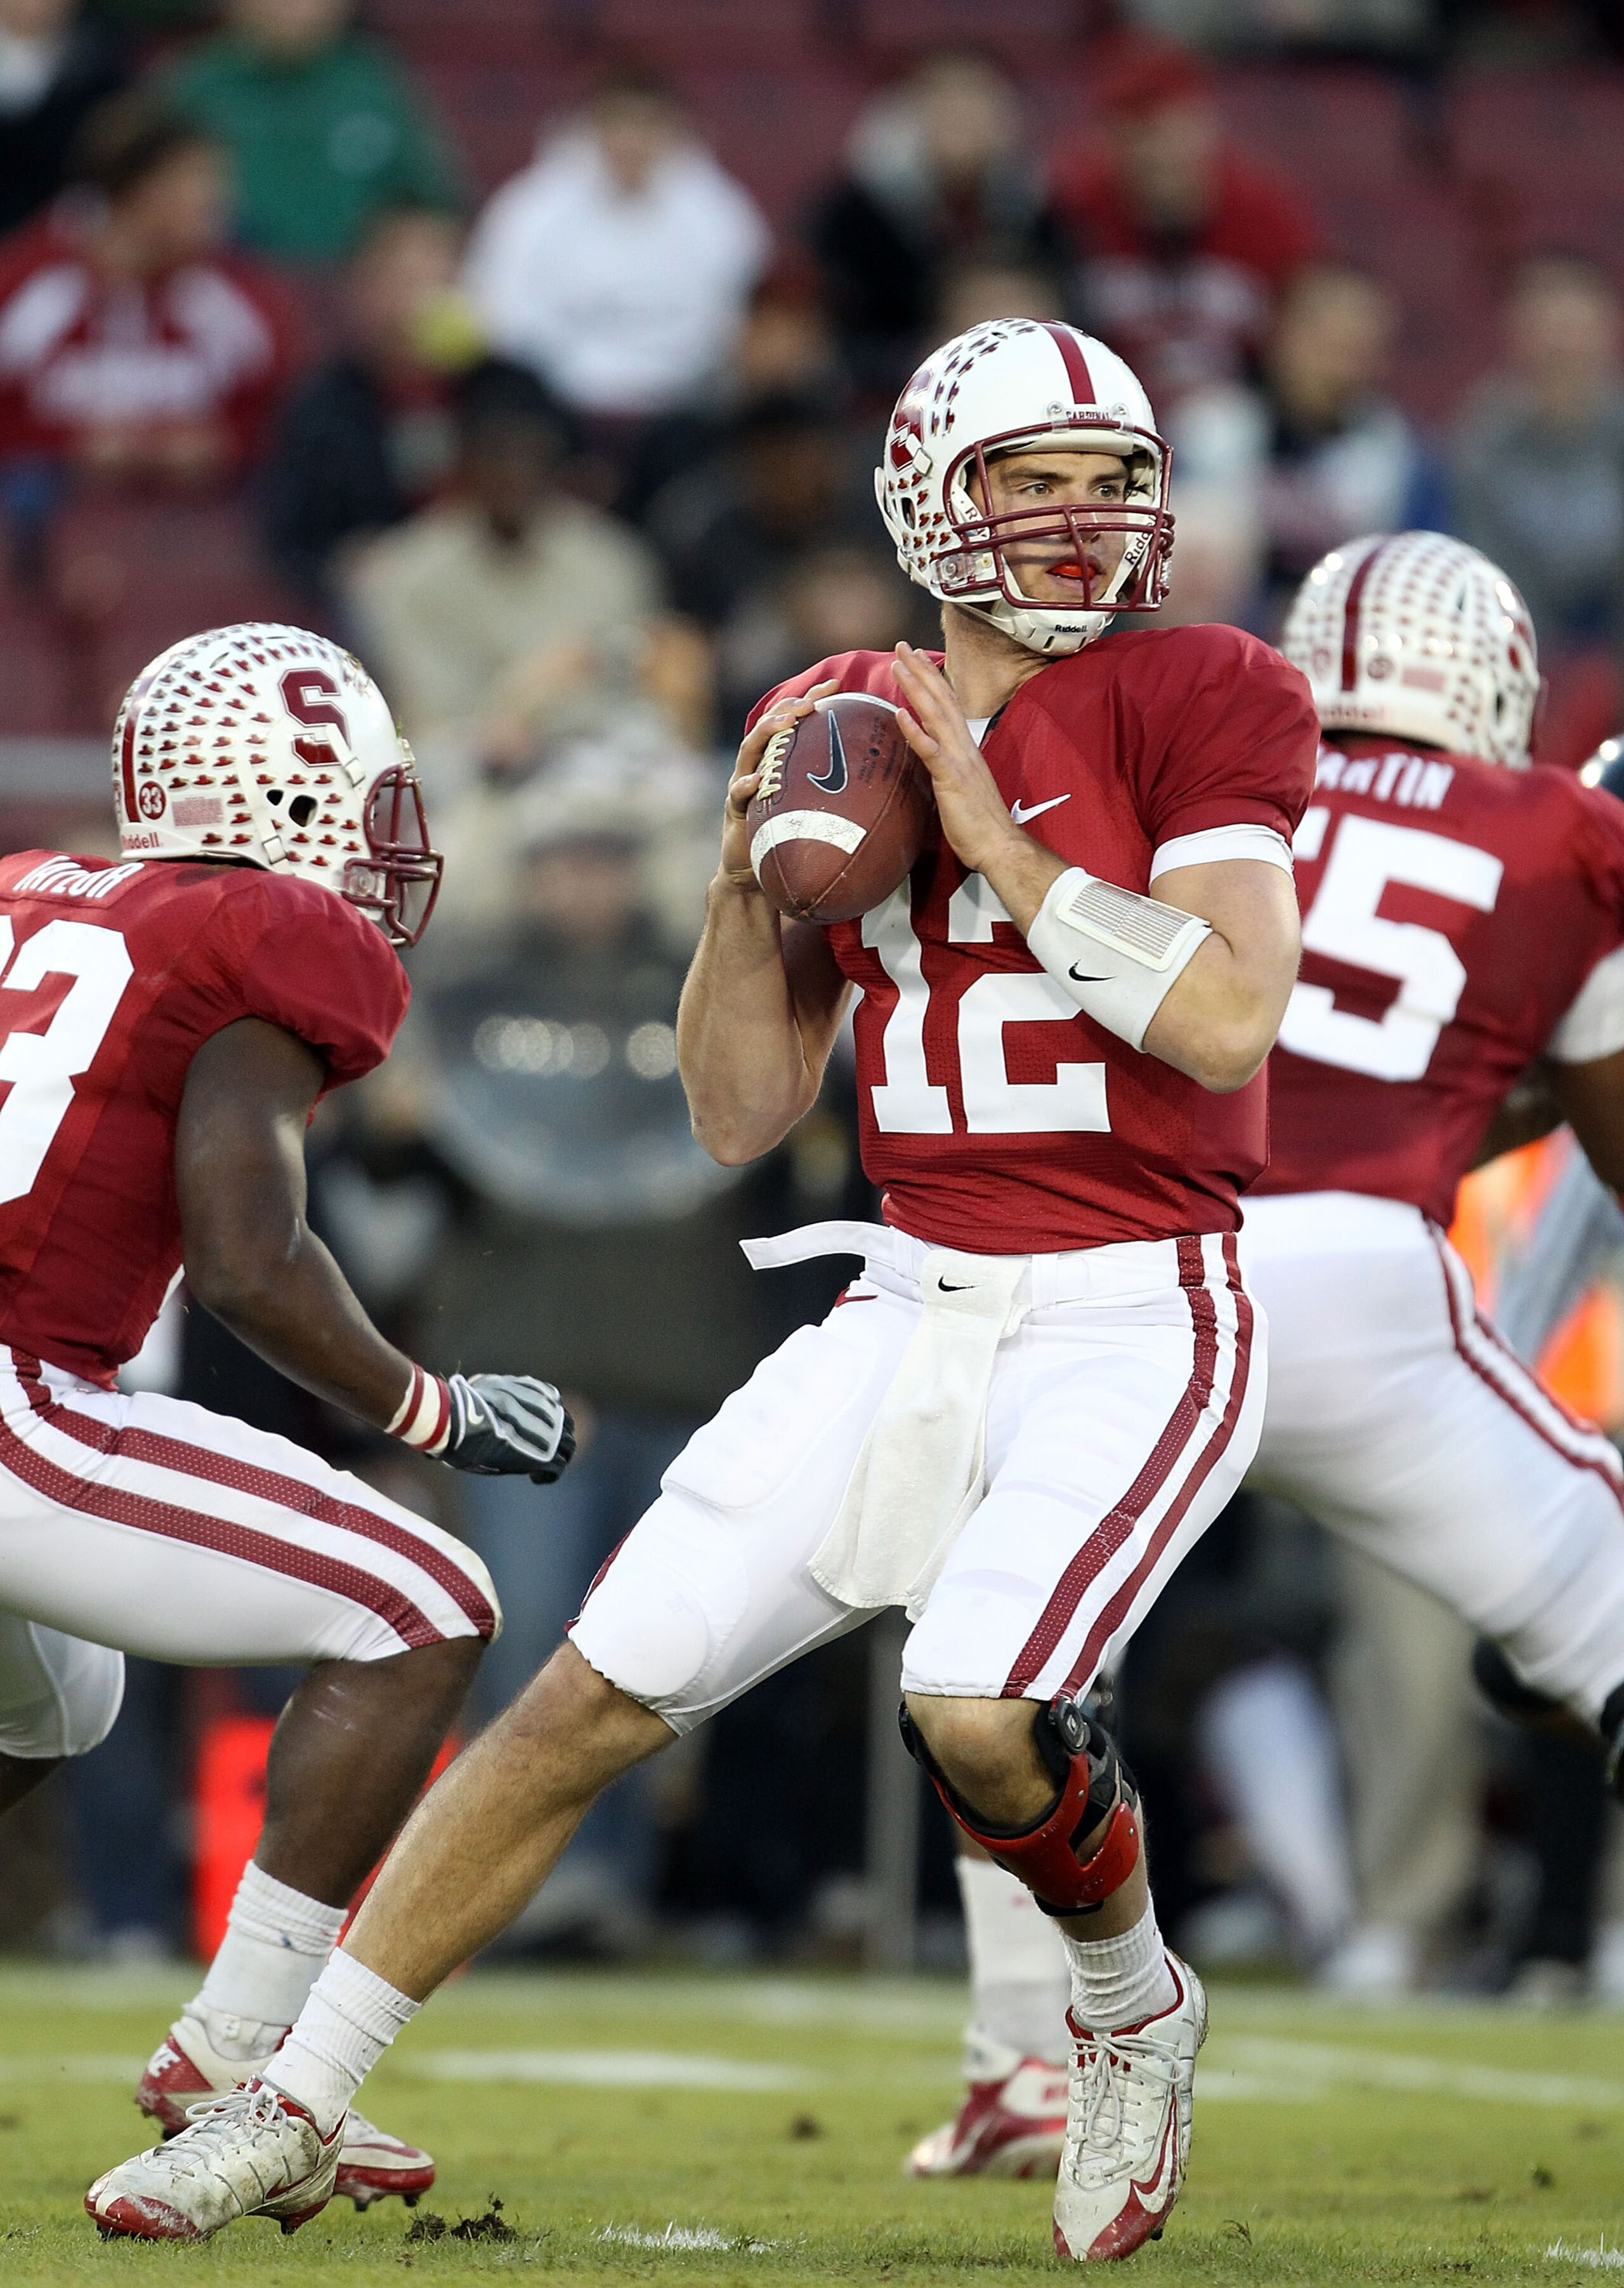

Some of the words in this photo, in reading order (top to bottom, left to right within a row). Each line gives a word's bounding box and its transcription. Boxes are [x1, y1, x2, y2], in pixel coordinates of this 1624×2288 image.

[1055, 624, 1087, 633] Riddell
[278, 667, 351, 768] S
[141, 787, 163, 814] 33
[1314, 744, 1455, 811] ARTIN
[121, 832, 160, 850] ddell
[1278, 805, 1504, 1082] 5
[861, 872, 1111, 1134] 12
[0, 914, 134, 1204] 3
